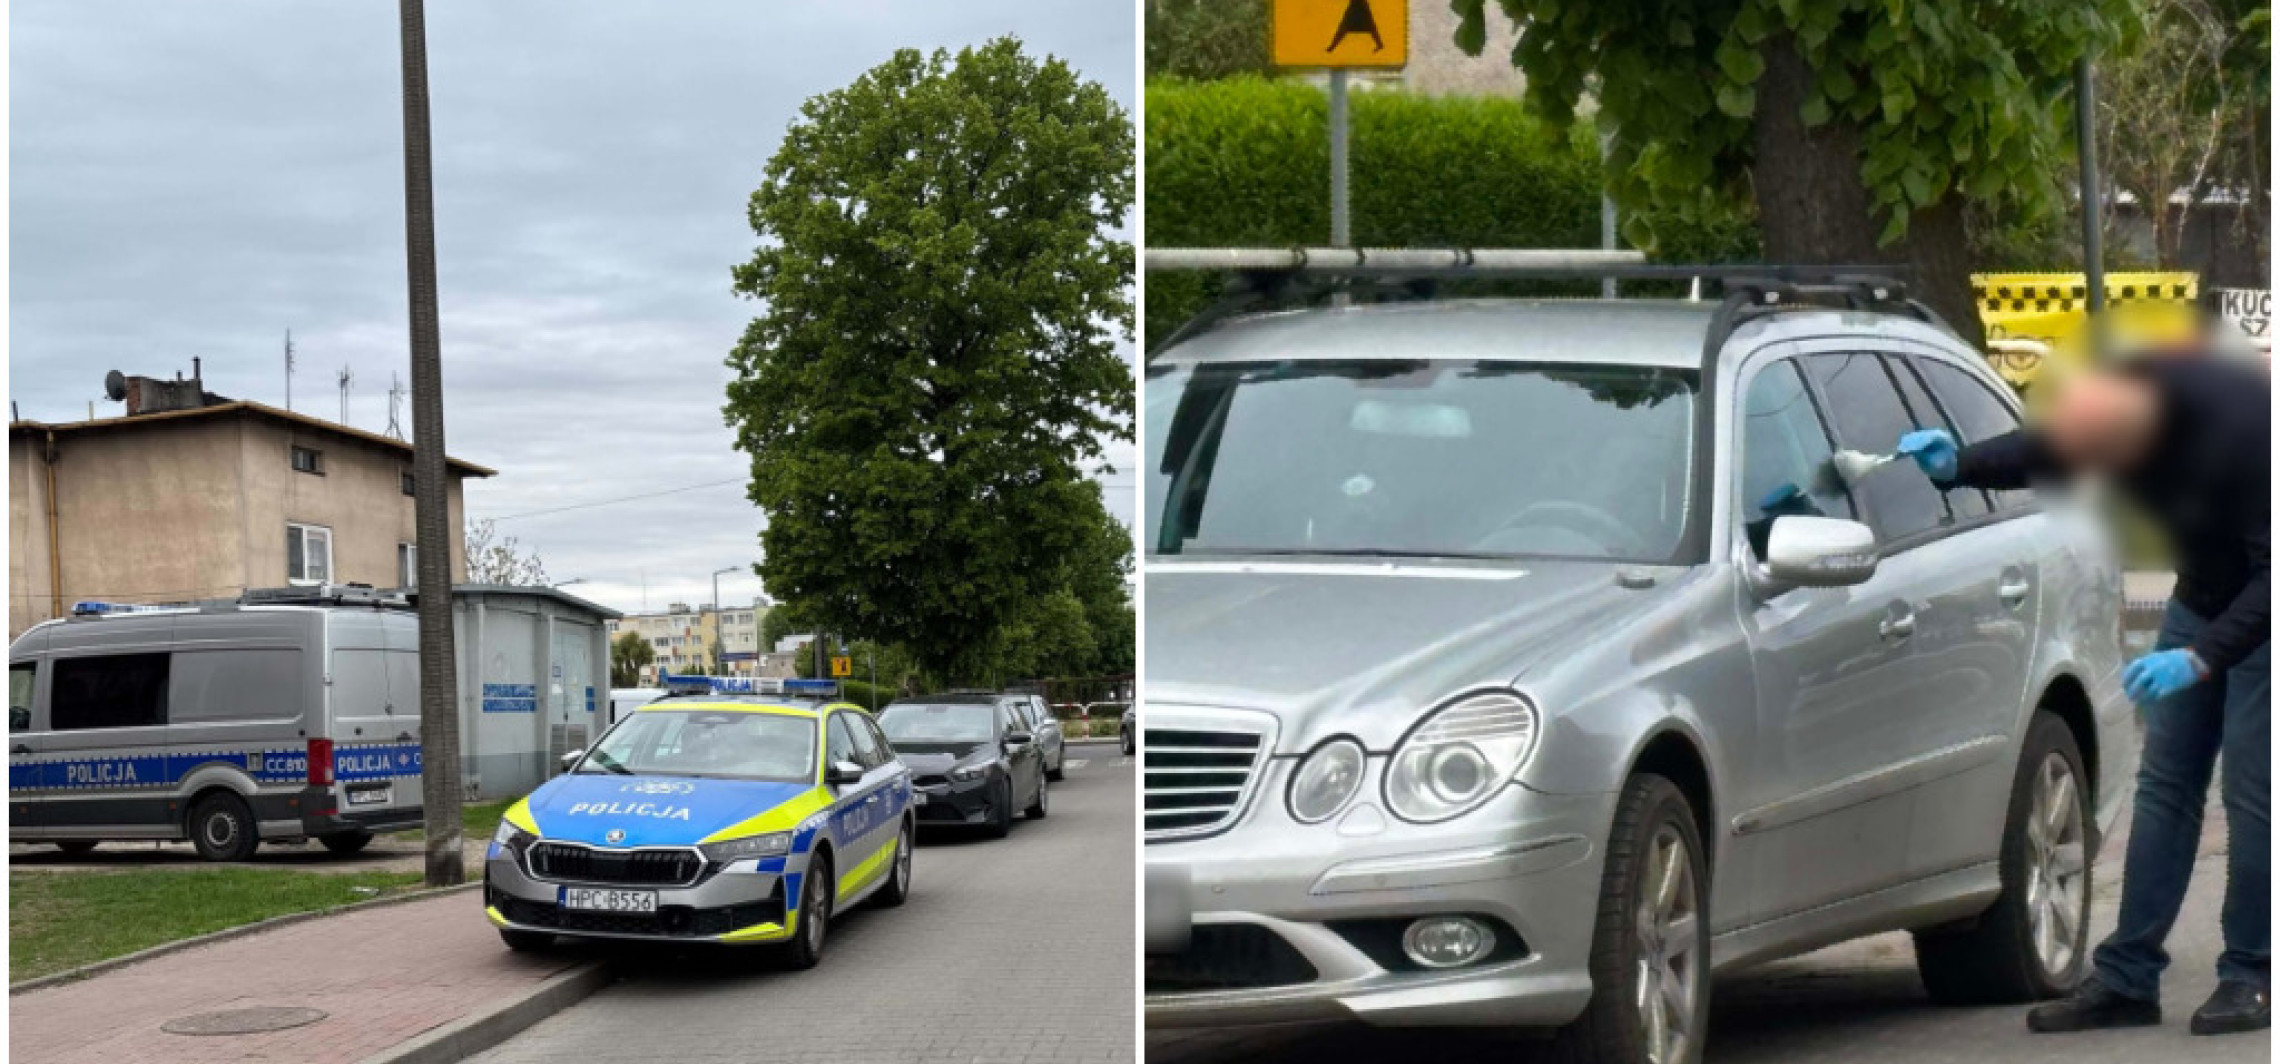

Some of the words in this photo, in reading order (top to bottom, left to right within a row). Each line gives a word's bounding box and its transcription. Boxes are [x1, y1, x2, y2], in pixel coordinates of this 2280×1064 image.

[67, 762, 137, 783] POLICJA
[338, 755, 391, 773] POLICJA
[569, 801, 690, 821] POLICJA
